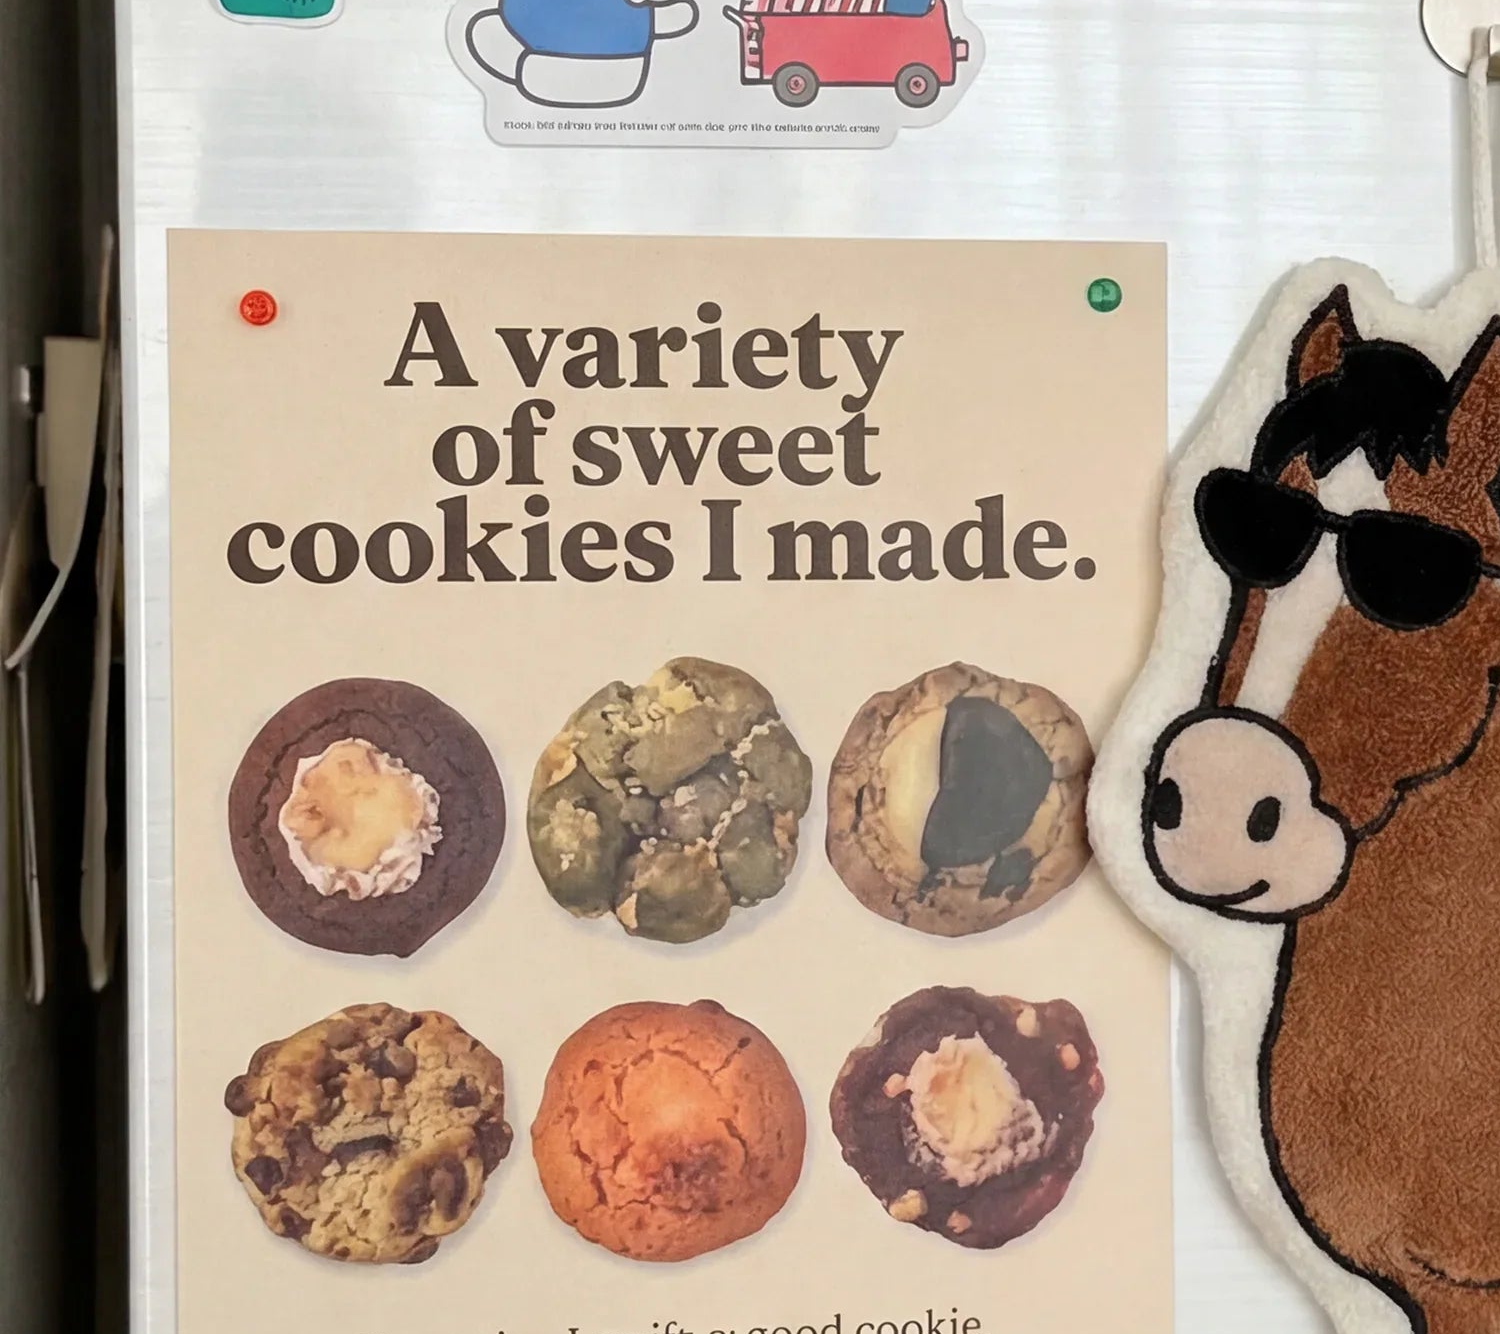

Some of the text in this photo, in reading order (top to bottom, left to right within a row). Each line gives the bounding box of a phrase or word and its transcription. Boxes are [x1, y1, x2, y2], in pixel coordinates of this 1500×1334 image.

[383, 301, 905, 407] A variety
[431, 398, 882, 487] of sweet
[226, 493, 1098, 585] cookies I made.
